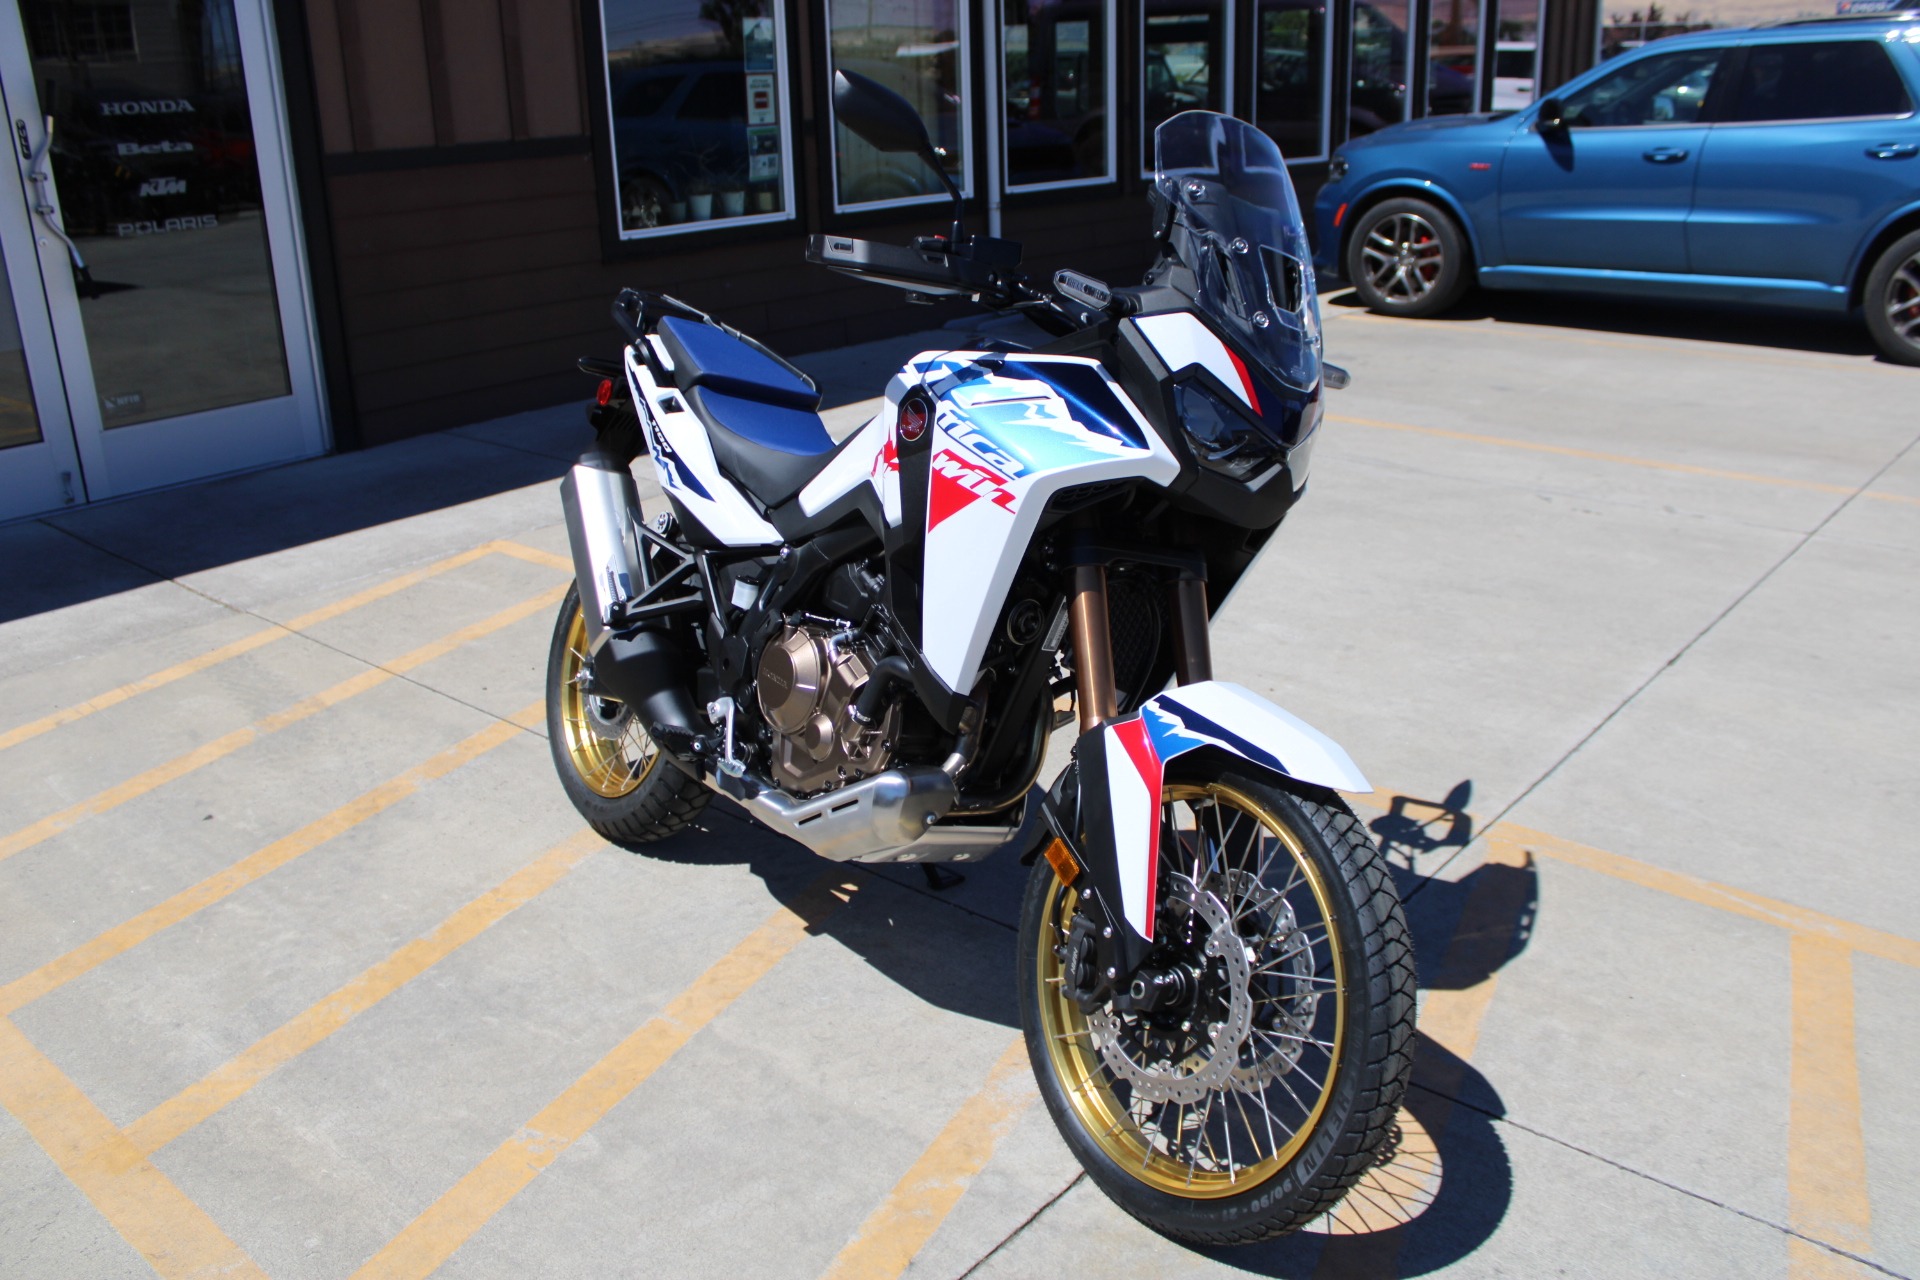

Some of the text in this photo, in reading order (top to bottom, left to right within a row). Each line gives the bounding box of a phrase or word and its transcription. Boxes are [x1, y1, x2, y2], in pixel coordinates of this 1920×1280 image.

[100, 99, 195, 116] HONDA
[116, 140, 193, 155] Beta
[139, 177, 187, 197] KTM
[118, 214, 218, 237] POLARIS
